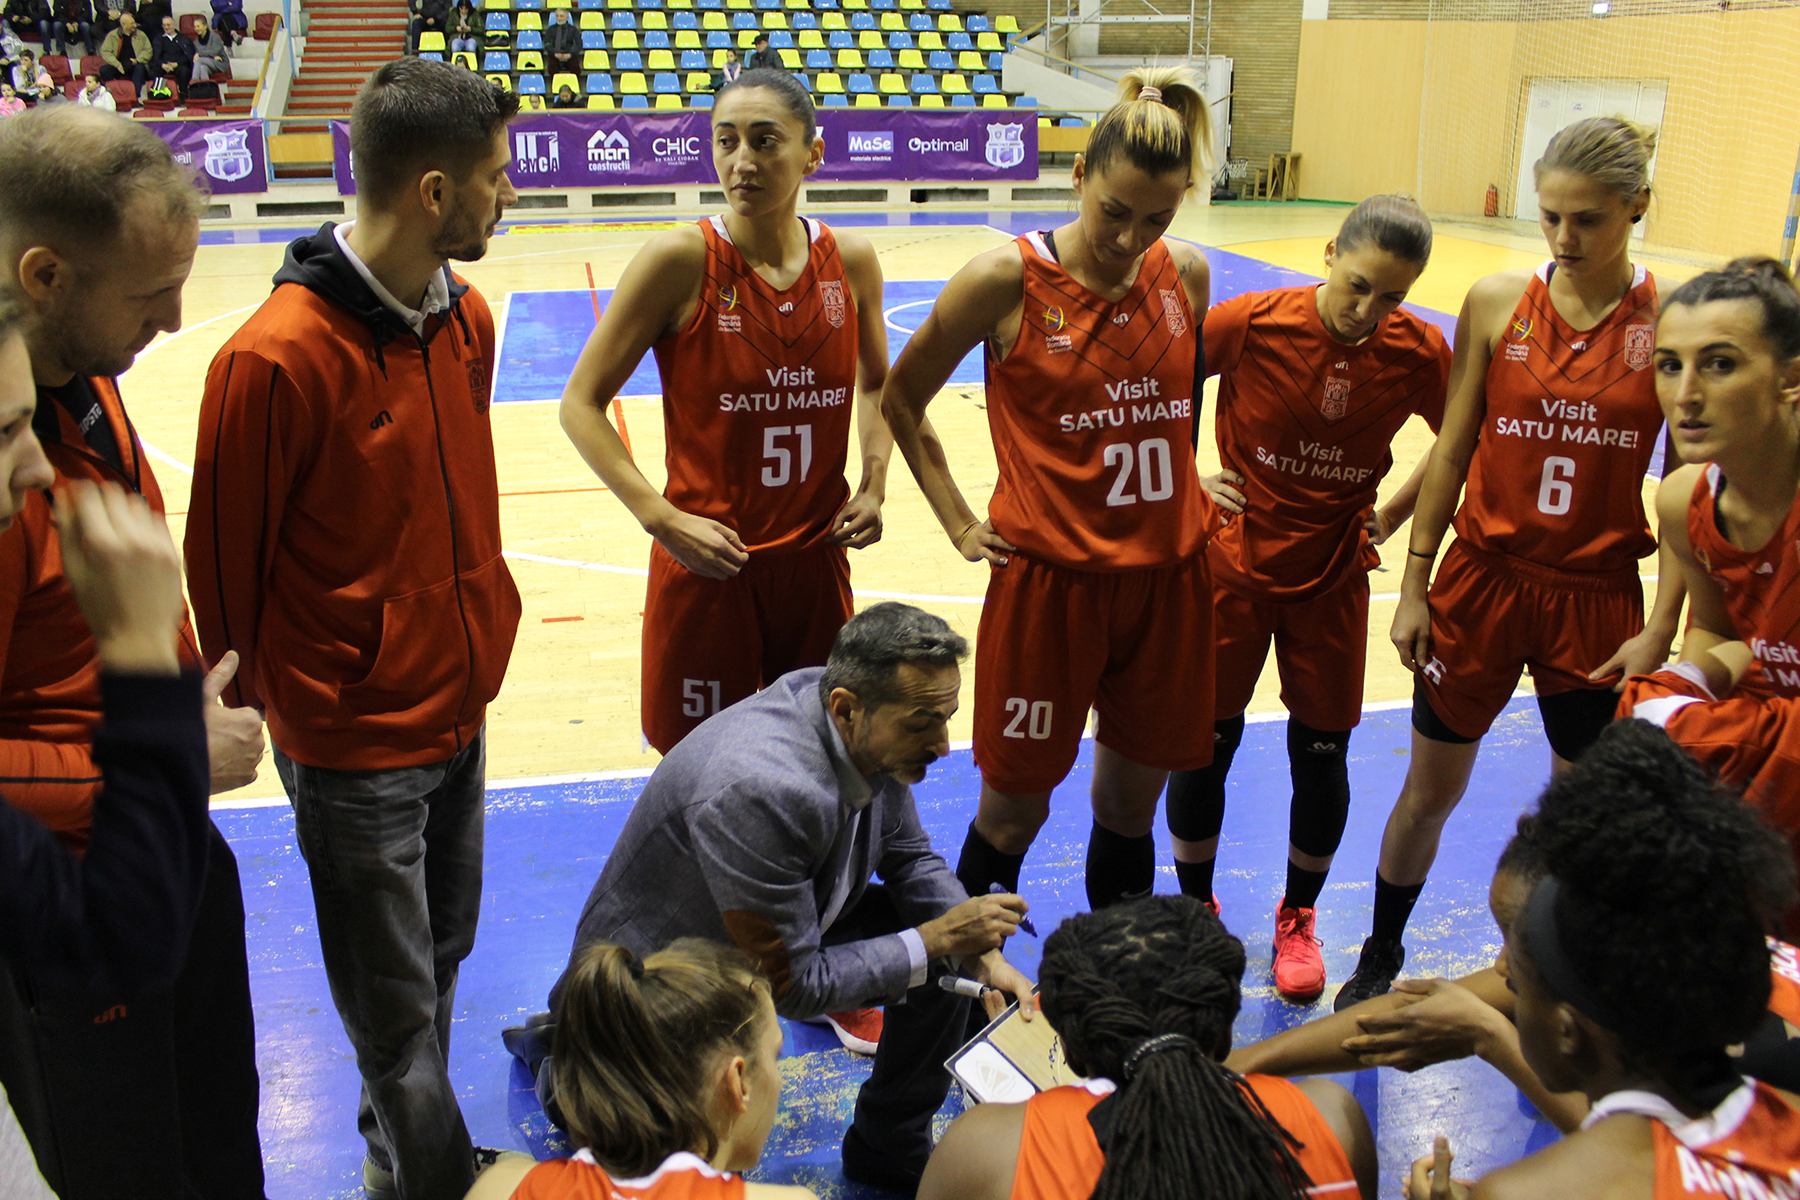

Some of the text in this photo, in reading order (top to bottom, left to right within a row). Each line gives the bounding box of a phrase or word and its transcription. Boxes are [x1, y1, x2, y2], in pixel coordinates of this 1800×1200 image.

[652, 136, 700, 156] CHIC
[849, 136, 891, 151] MaSe
[908, 137, 969, 154] Optimall
[766, 366, 815, 387] Visit
[1104, 376, 1160, 402] Visit
[719, 388, 846, 412] SATU MARE!
[1540, 398, 1597, 422] Visit
[1059, 407, 1125, 432] SATU
[1496, 417, 1638, 448] SATU MARE!
[761, 424, 813, 487] 51
[1256, 446, 1307, 475] SATU
[1299, 440, 1344, 462] Visit
[1103, 437, 1174, 507] 20
[1537, 455, 1576, 516] 6
[1751, 637, 1800, 665] Visit
[682, 678, 721, 717] 51
[1003, 697, 1054, 740] 20
